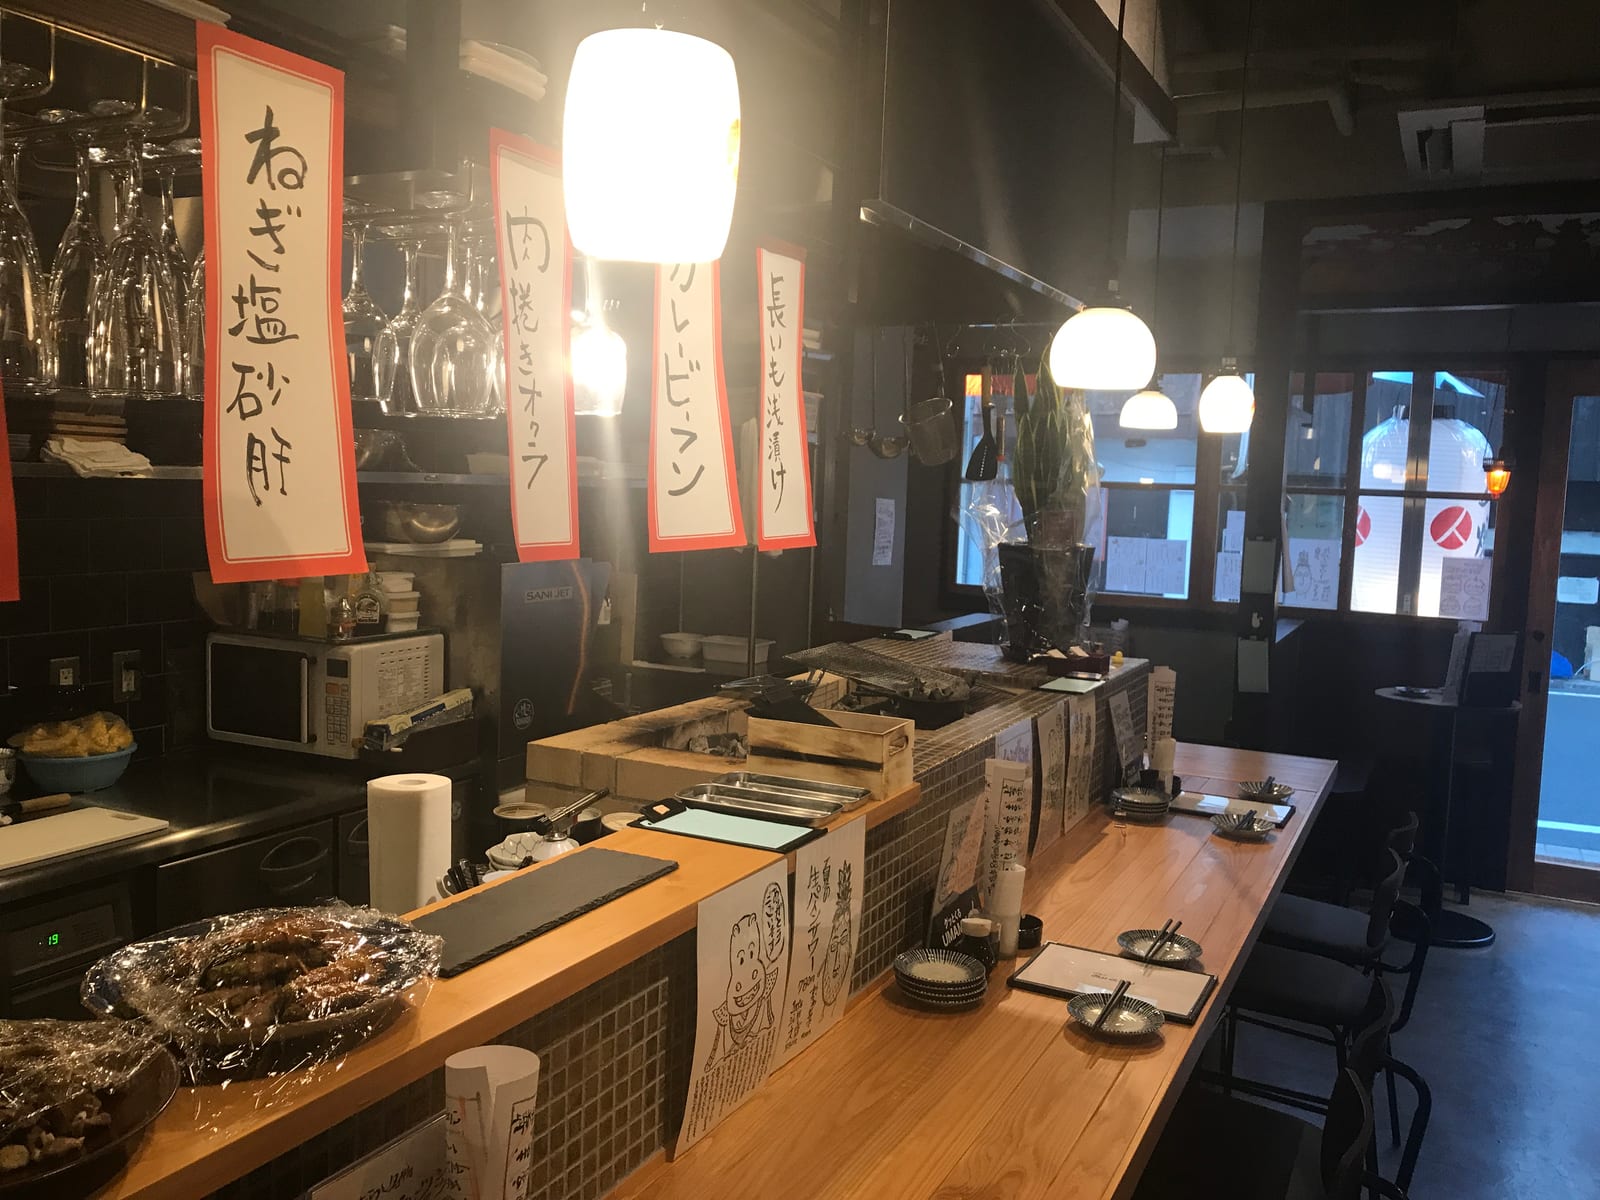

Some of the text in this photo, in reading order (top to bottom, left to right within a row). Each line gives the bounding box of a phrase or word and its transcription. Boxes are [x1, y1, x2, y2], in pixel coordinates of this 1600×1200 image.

[227, 105, 308, 507] ねぎ塩砂肝
[765, 271, 786, 513] 長いも浅漬け
[526, 589, 553, 602] SANI
[48, 933, 59, 946] 19
